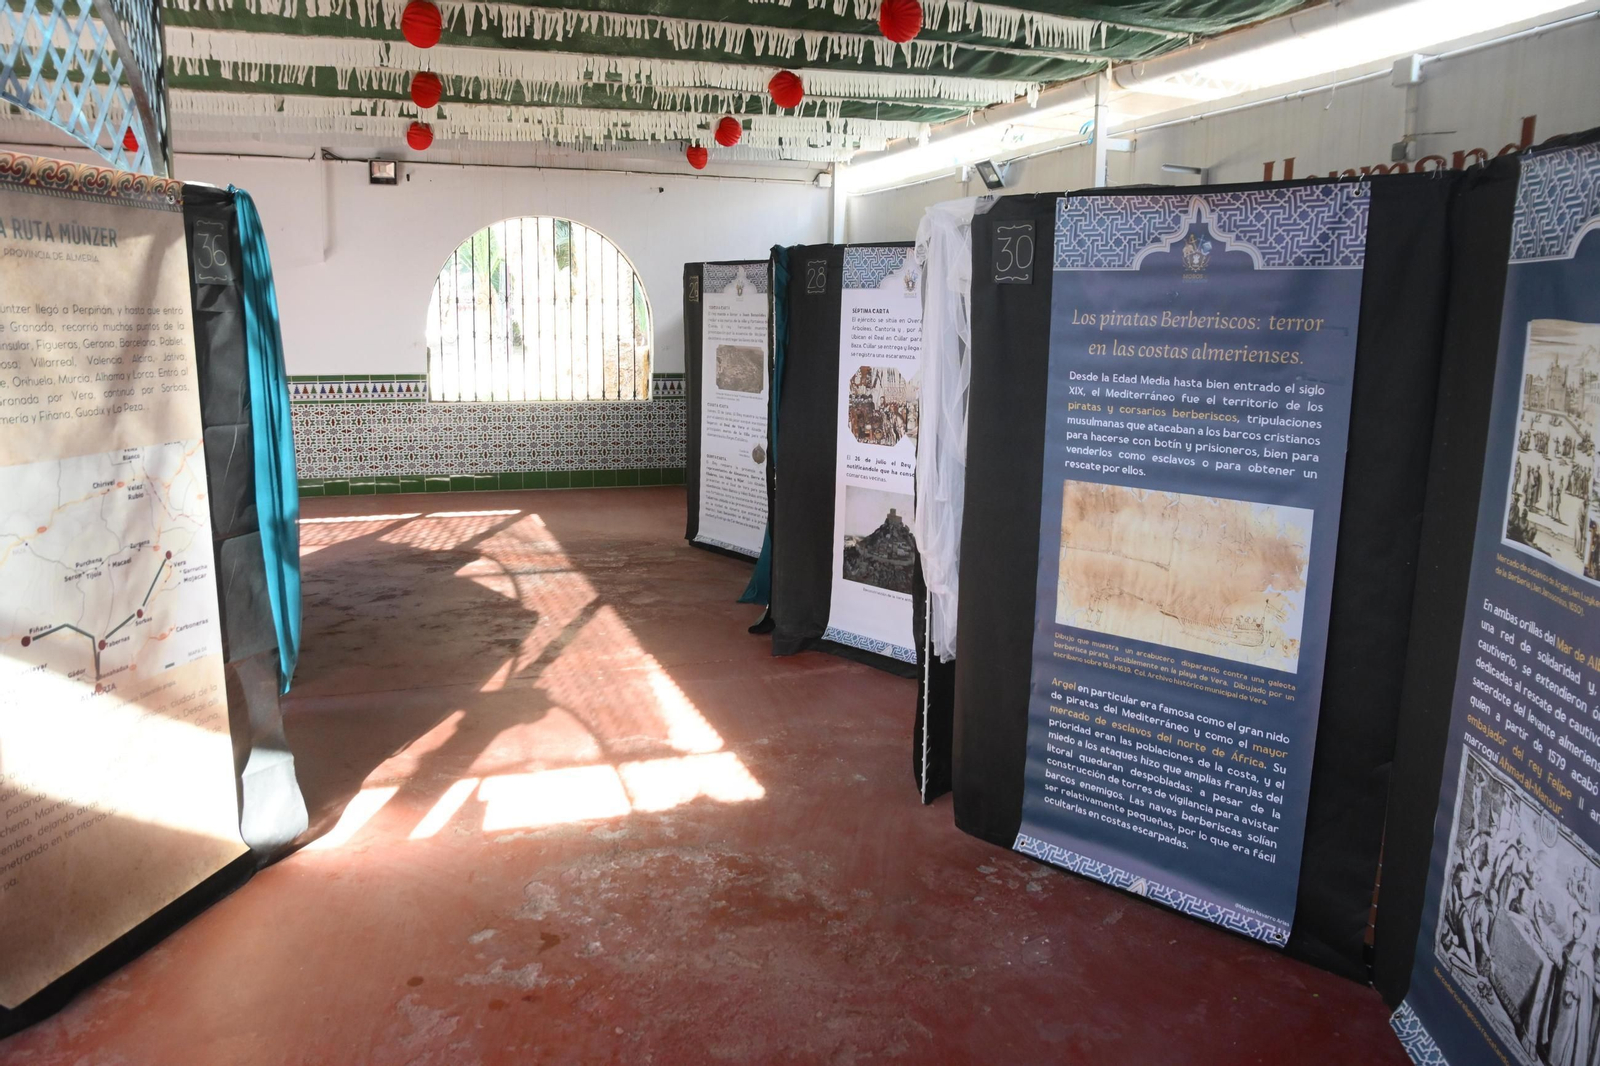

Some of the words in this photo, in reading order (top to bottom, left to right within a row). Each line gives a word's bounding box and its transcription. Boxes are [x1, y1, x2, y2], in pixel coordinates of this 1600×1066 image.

[11, 218, 55, 242] RUTA
[59, 220, 118, 248] MÜNZER
[4, 248, 51, 259] PROVINCIA
[53, 252, 64, 261] DE
[66, 252, 99, 262] ALMERÍA
[197, 233, 228, 269] 36
[996, 235, 1034, 273] 30
[807, 266, 827, 289] 28
[35, 304, 59, 316] llegó
[117, 307, 122, 316] y
[125, 305, 145, 315] hasta
[1072, 309, 1096, 325] Los
[1099, 310, 1158, 331] piratas
[1161, 310, 1260, 330] Berberiscos:
[1269, 315, 1324, 331] terror
[1088, 343, 1106, 355] en
[1112, 339, 1135, 357] las
[1138, 344, 1188, 359] costas
[1191, 342, 1303, 364] almerienses.
[1069, 370, 1098, 381] Desde
[1101, 372, 1109, 382] la
[1112, 373, 1137, 383] Edad
[1140, 375, 1170, 386] Media
[1173, 376, 1202, 388] hasta
[1206, 378, 1229, 389] bien
[1233, 382, 1280, 392] entrado
[1284, 383, 1294, 393] el
[1298, 384, 1324, 396] siglo
[1068, 386, 1085, 396] XIX,
[1091, 387, 1100, 396] el
[1105, 388, 1175, 401] Mediterráneo
[1181, 393, 1199, 403] fue
[1206, 394, 1216, 404] el
[1222, 396, 1278, 408] territorio
[1285, 400, 1300, 410] de
[1307, 400, 1323, 412] los
[32, 414, 36, 424] y
[1068, 401, 1101, 411] piratas
[1107, 405, 1113, 414] y
[1119, 405, 1166, 417] corsarios
[1172, 408, 1240, 423] berberiscos,
[1247, 414, 1322, 428] tripulaciones
[1066, 416, 1124, 428] musulmanas
[1126, 422, 1145, 431] que
[1147, 423, 1195, 434] atacaban
[1205, 426, 1220, 437] los
[1222, 427, 1261, 440] barcos
[1263, 432, 1320, 445] cristianos
[92, 480, 116, 489] Chirivel
[75, 556, 102, 568] Purchena
[112, 557, 132, 568] Macael
[173, 560, 187, 568] Vera
[1483, 598, 1492, 612] En
[1493, 606, 1518, 625] ambas
[1519, 619, 1542, 638] orillas
[1544, 630, 1556, 646] del
[1556, 637, 1572, 654] Mar
[1574, 649, 1585, 663] de
[1054, 631, 1074, 642] Dibujo
[1092, 640, 1119, 652] muestra
[1136, 650, 1174, 663] arcabucero
[1181, 659, 1220, 675] disparando
[1223, 670, 1248, 680] contra
[1268, 680, 1295, 690] galeota
[1481, 620, 1494, 634] una
[1500, 630, 1514, 644] red
[1520, 639, 1531, 654] de
[1537, 650, 1580, 684] solidaridad
[1588, 681, 1596, 696] y,
[1050, 690, 1062, 700] de
[1066, 695, 1098, 709] piratas
[1103, 703, 1117, 714] del
[1121, 707, 1189, 732] Mediterráneo
[1193, 728, 1200, 738] y
[1204, 731, 1233, 744] como
[1238, 739, 1247, 748] el
[1252, 744, 1287, 757] mayor
[1052, 677, 1076, 690] Argel
[1077, 685, 1088, 694] en
[1090, 688, 1138, 705] particular
[1140, 700, 1156, 710] era
[1158, 703, 1194, 720] famosa
[1196, 714, 1224, 727] como
[1226, 721, 1236, 730] el
[1238, 725, 1263, 737] gran
[1265, 731, 1289, 744] nido
[1467, 714, 1506, 746] embajador
[1512, 744, 1524, 761] del
[1528, 759, 1542, 778] rey
[1547, 771, 1572, 799] Felipe
[1470, 695, 1490, 715] quien
[1495, 712, 1500, 722] a
[1504, 718, 1528, 740] partir
[1532, 738, 1542, 753] de
[1548, 748, 1566, 770] 1579
[1570, 769, 1598, 796] acabó
